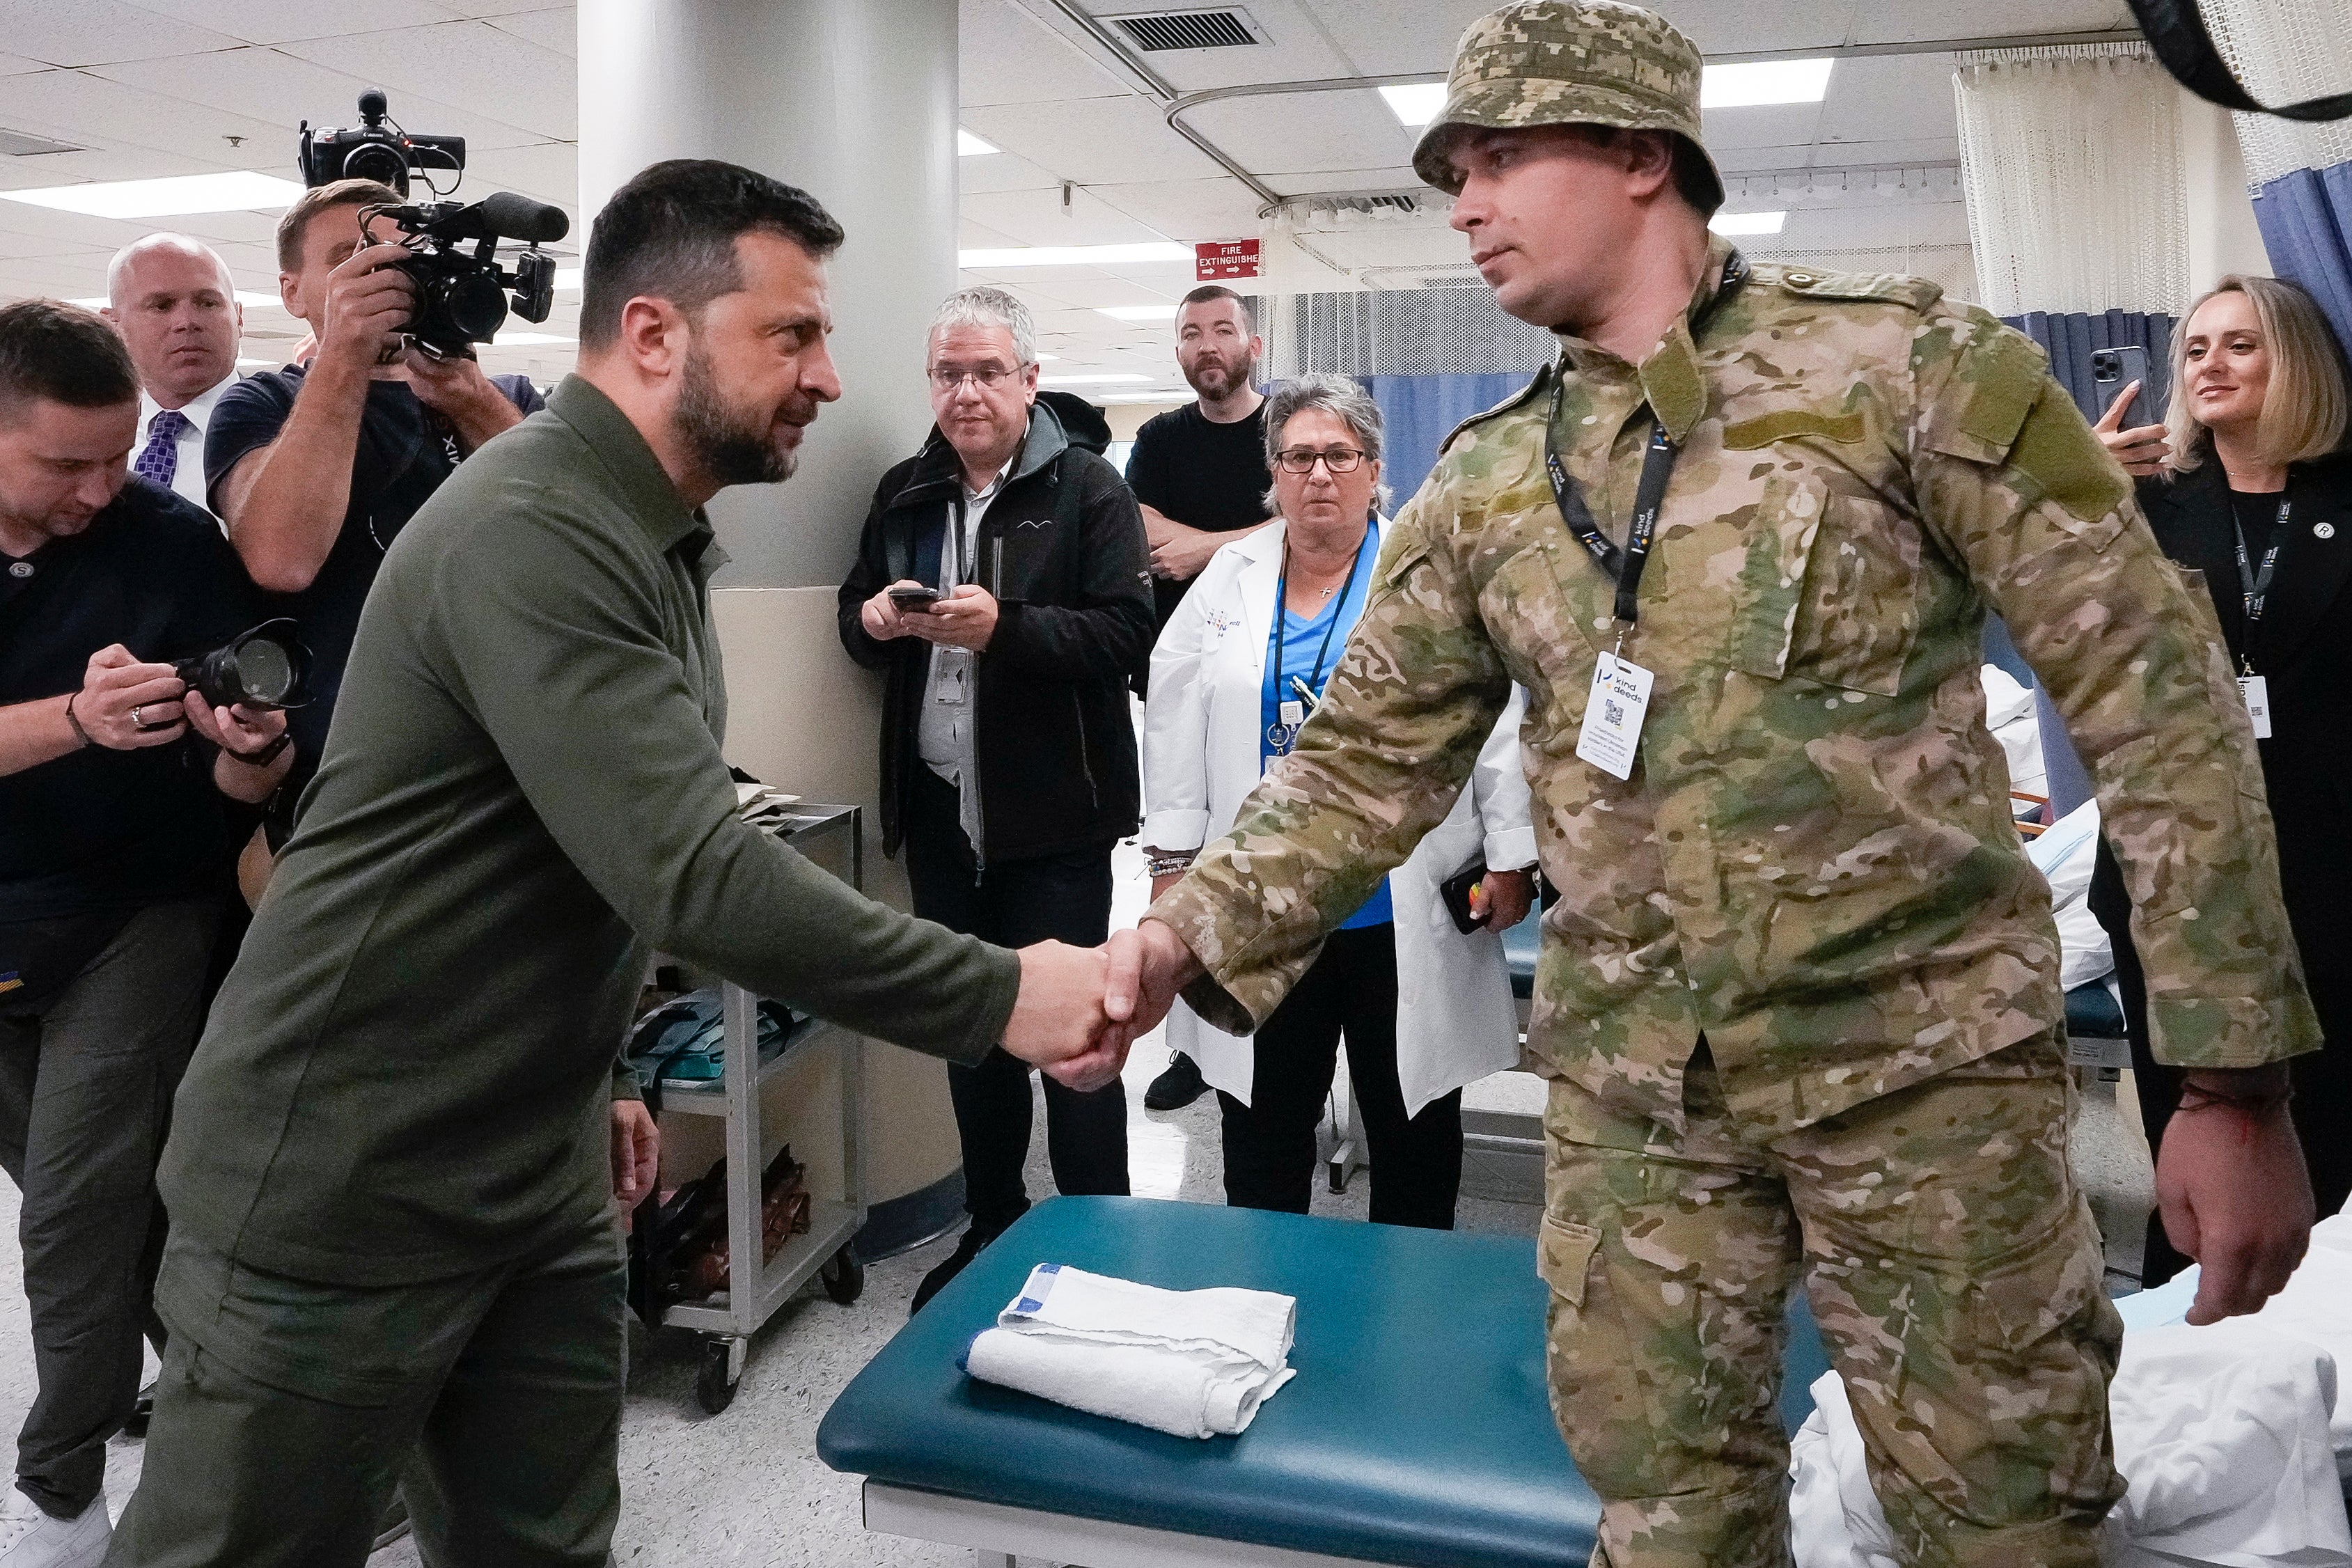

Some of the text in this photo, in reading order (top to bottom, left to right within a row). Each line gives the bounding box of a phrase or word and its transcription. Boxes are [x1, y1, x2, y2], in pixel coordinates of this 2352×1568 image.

[1221, 246, 1242, 256] FIRE
[1199, 254, 1259, 267] EXTINGUISHE
[1635, 514, 1646, 535] kind
[2319, 526, 2329, 535] R
[1616, 676, 1637, 691] kind
